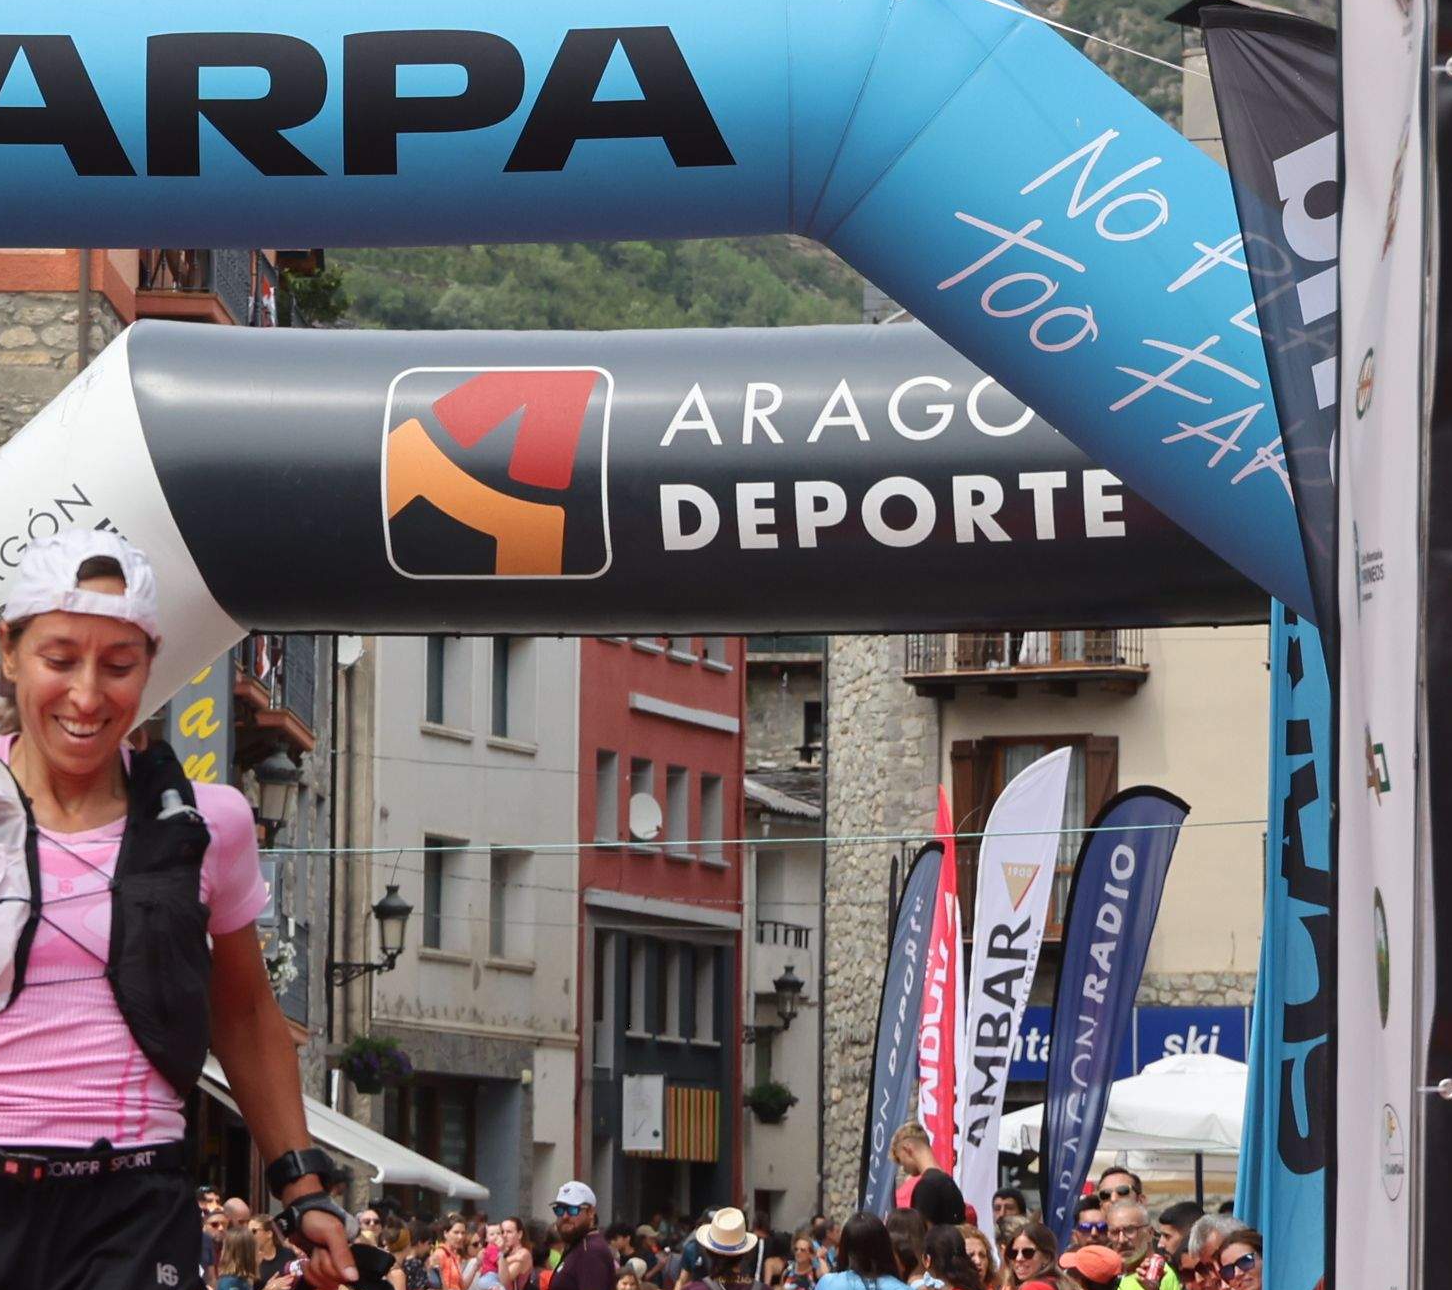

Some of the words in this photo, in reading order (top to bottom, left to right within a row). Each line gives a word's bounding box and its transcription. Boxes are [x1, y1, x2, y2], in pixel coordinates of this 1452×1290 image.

[660, 376, 1052, 447] ARAGO
[660, 469, 1126, 551] DEPORTE
[1083, 843, 1136, 1005] RADIO
[967, 915, 1032, 1147] AMBAR
[1163, 1025, 1220, 1058] ski
